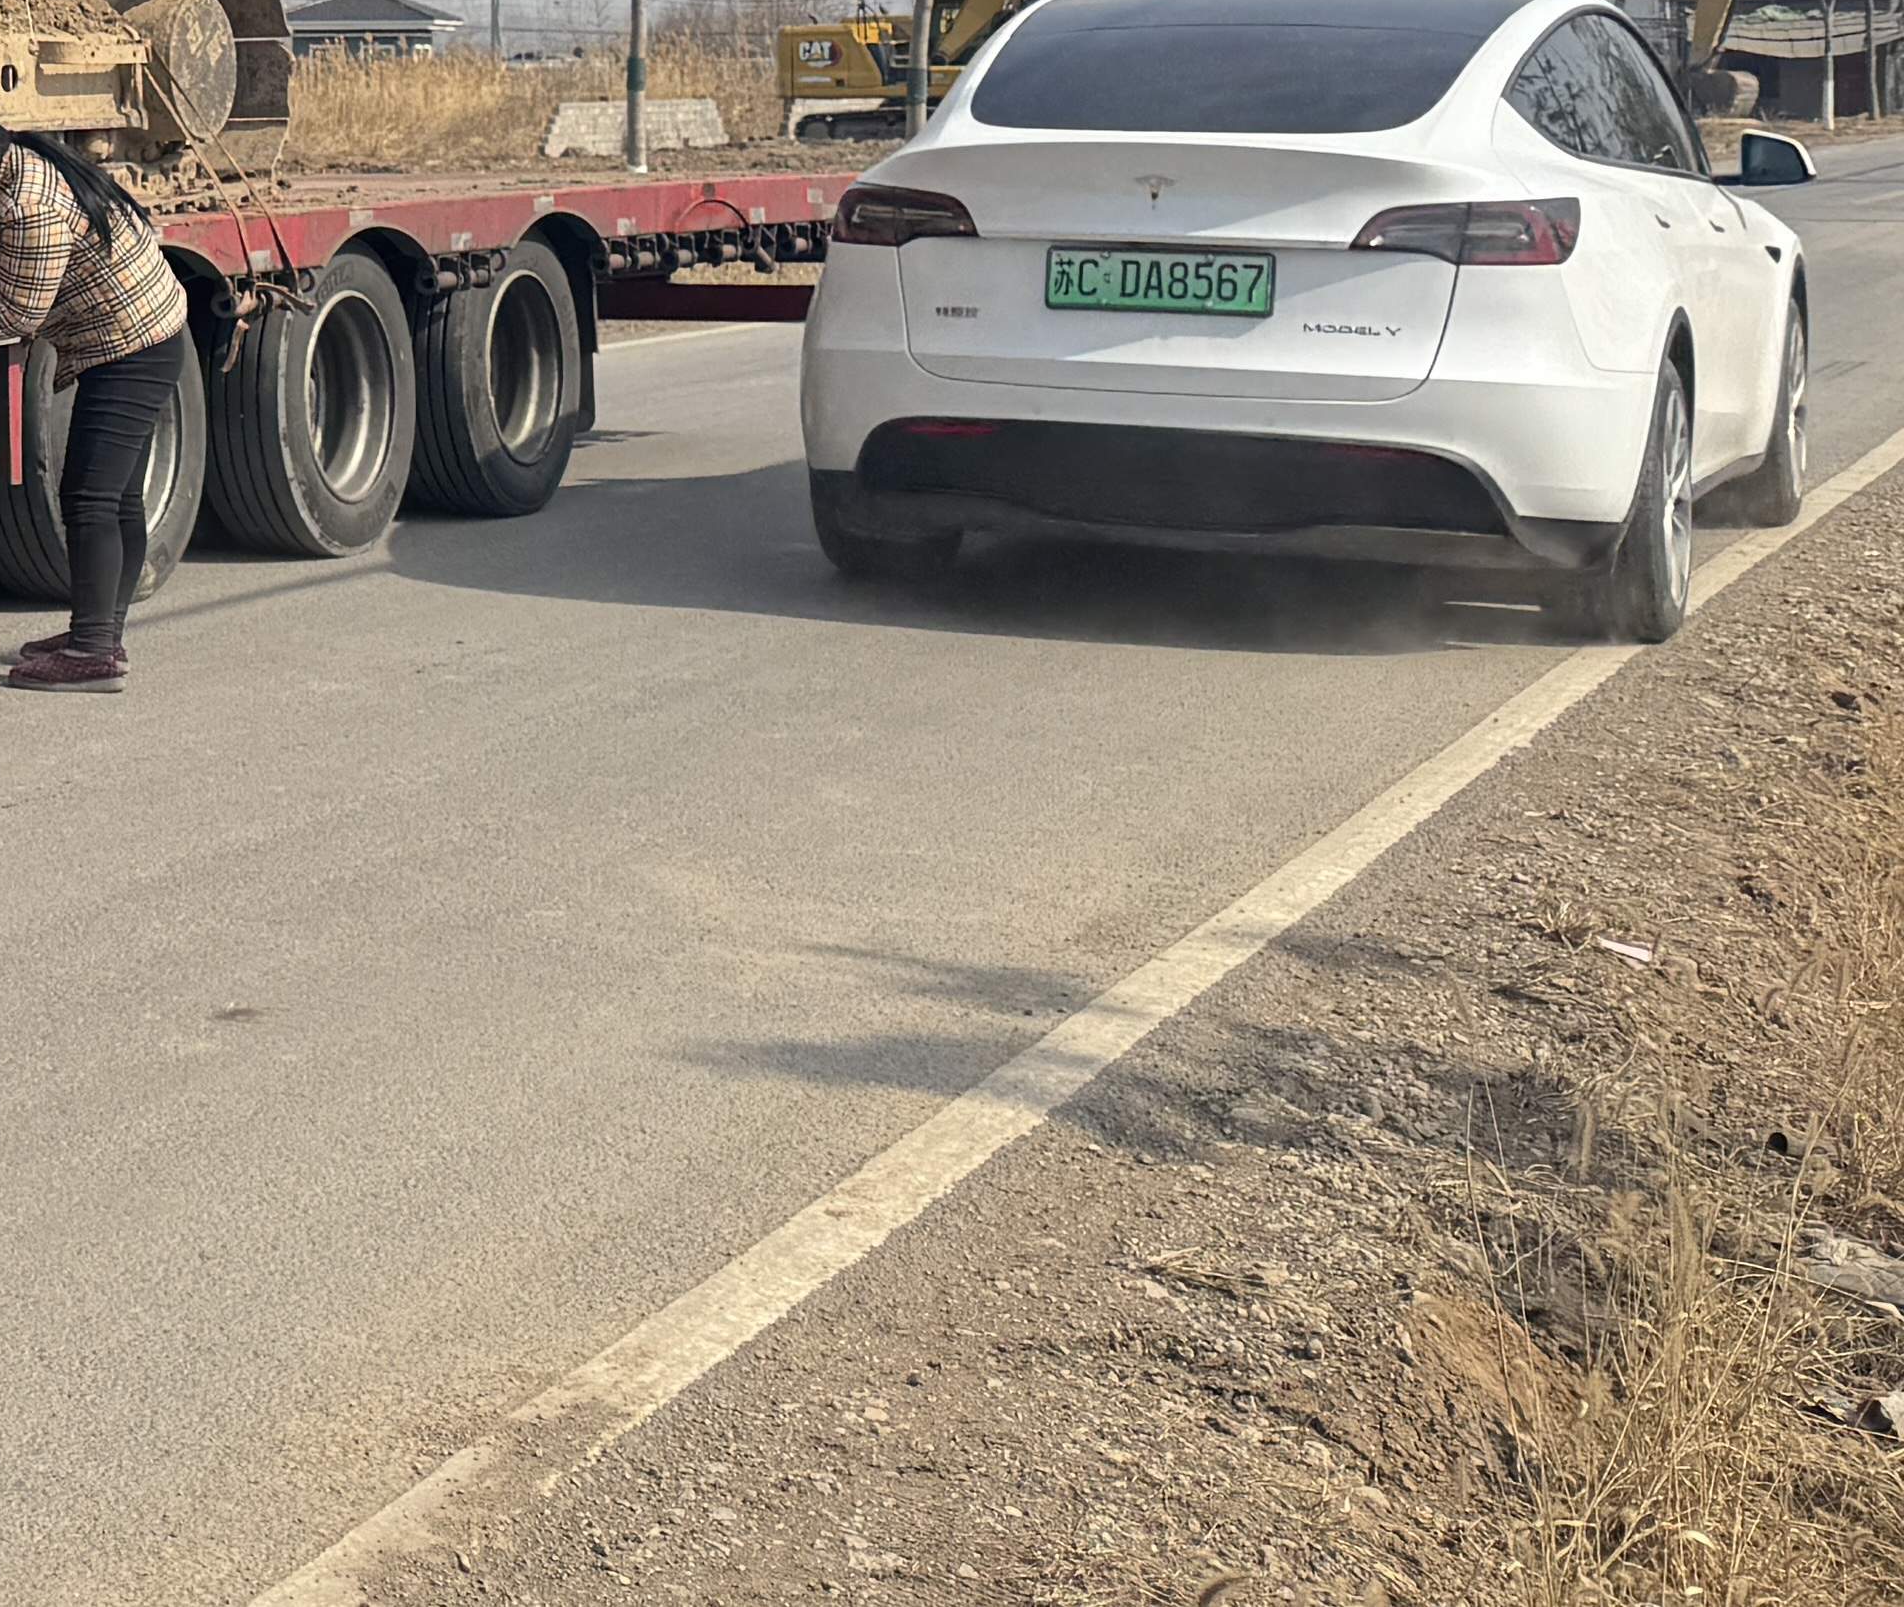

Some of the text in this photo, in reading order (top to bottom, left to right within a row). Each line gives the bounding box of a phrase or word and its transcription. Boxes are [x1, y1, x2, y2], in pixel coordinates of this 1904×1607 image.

[799, 41, 833, 62] CAT
[1303, 323, 1402, 337] MODEL Y
